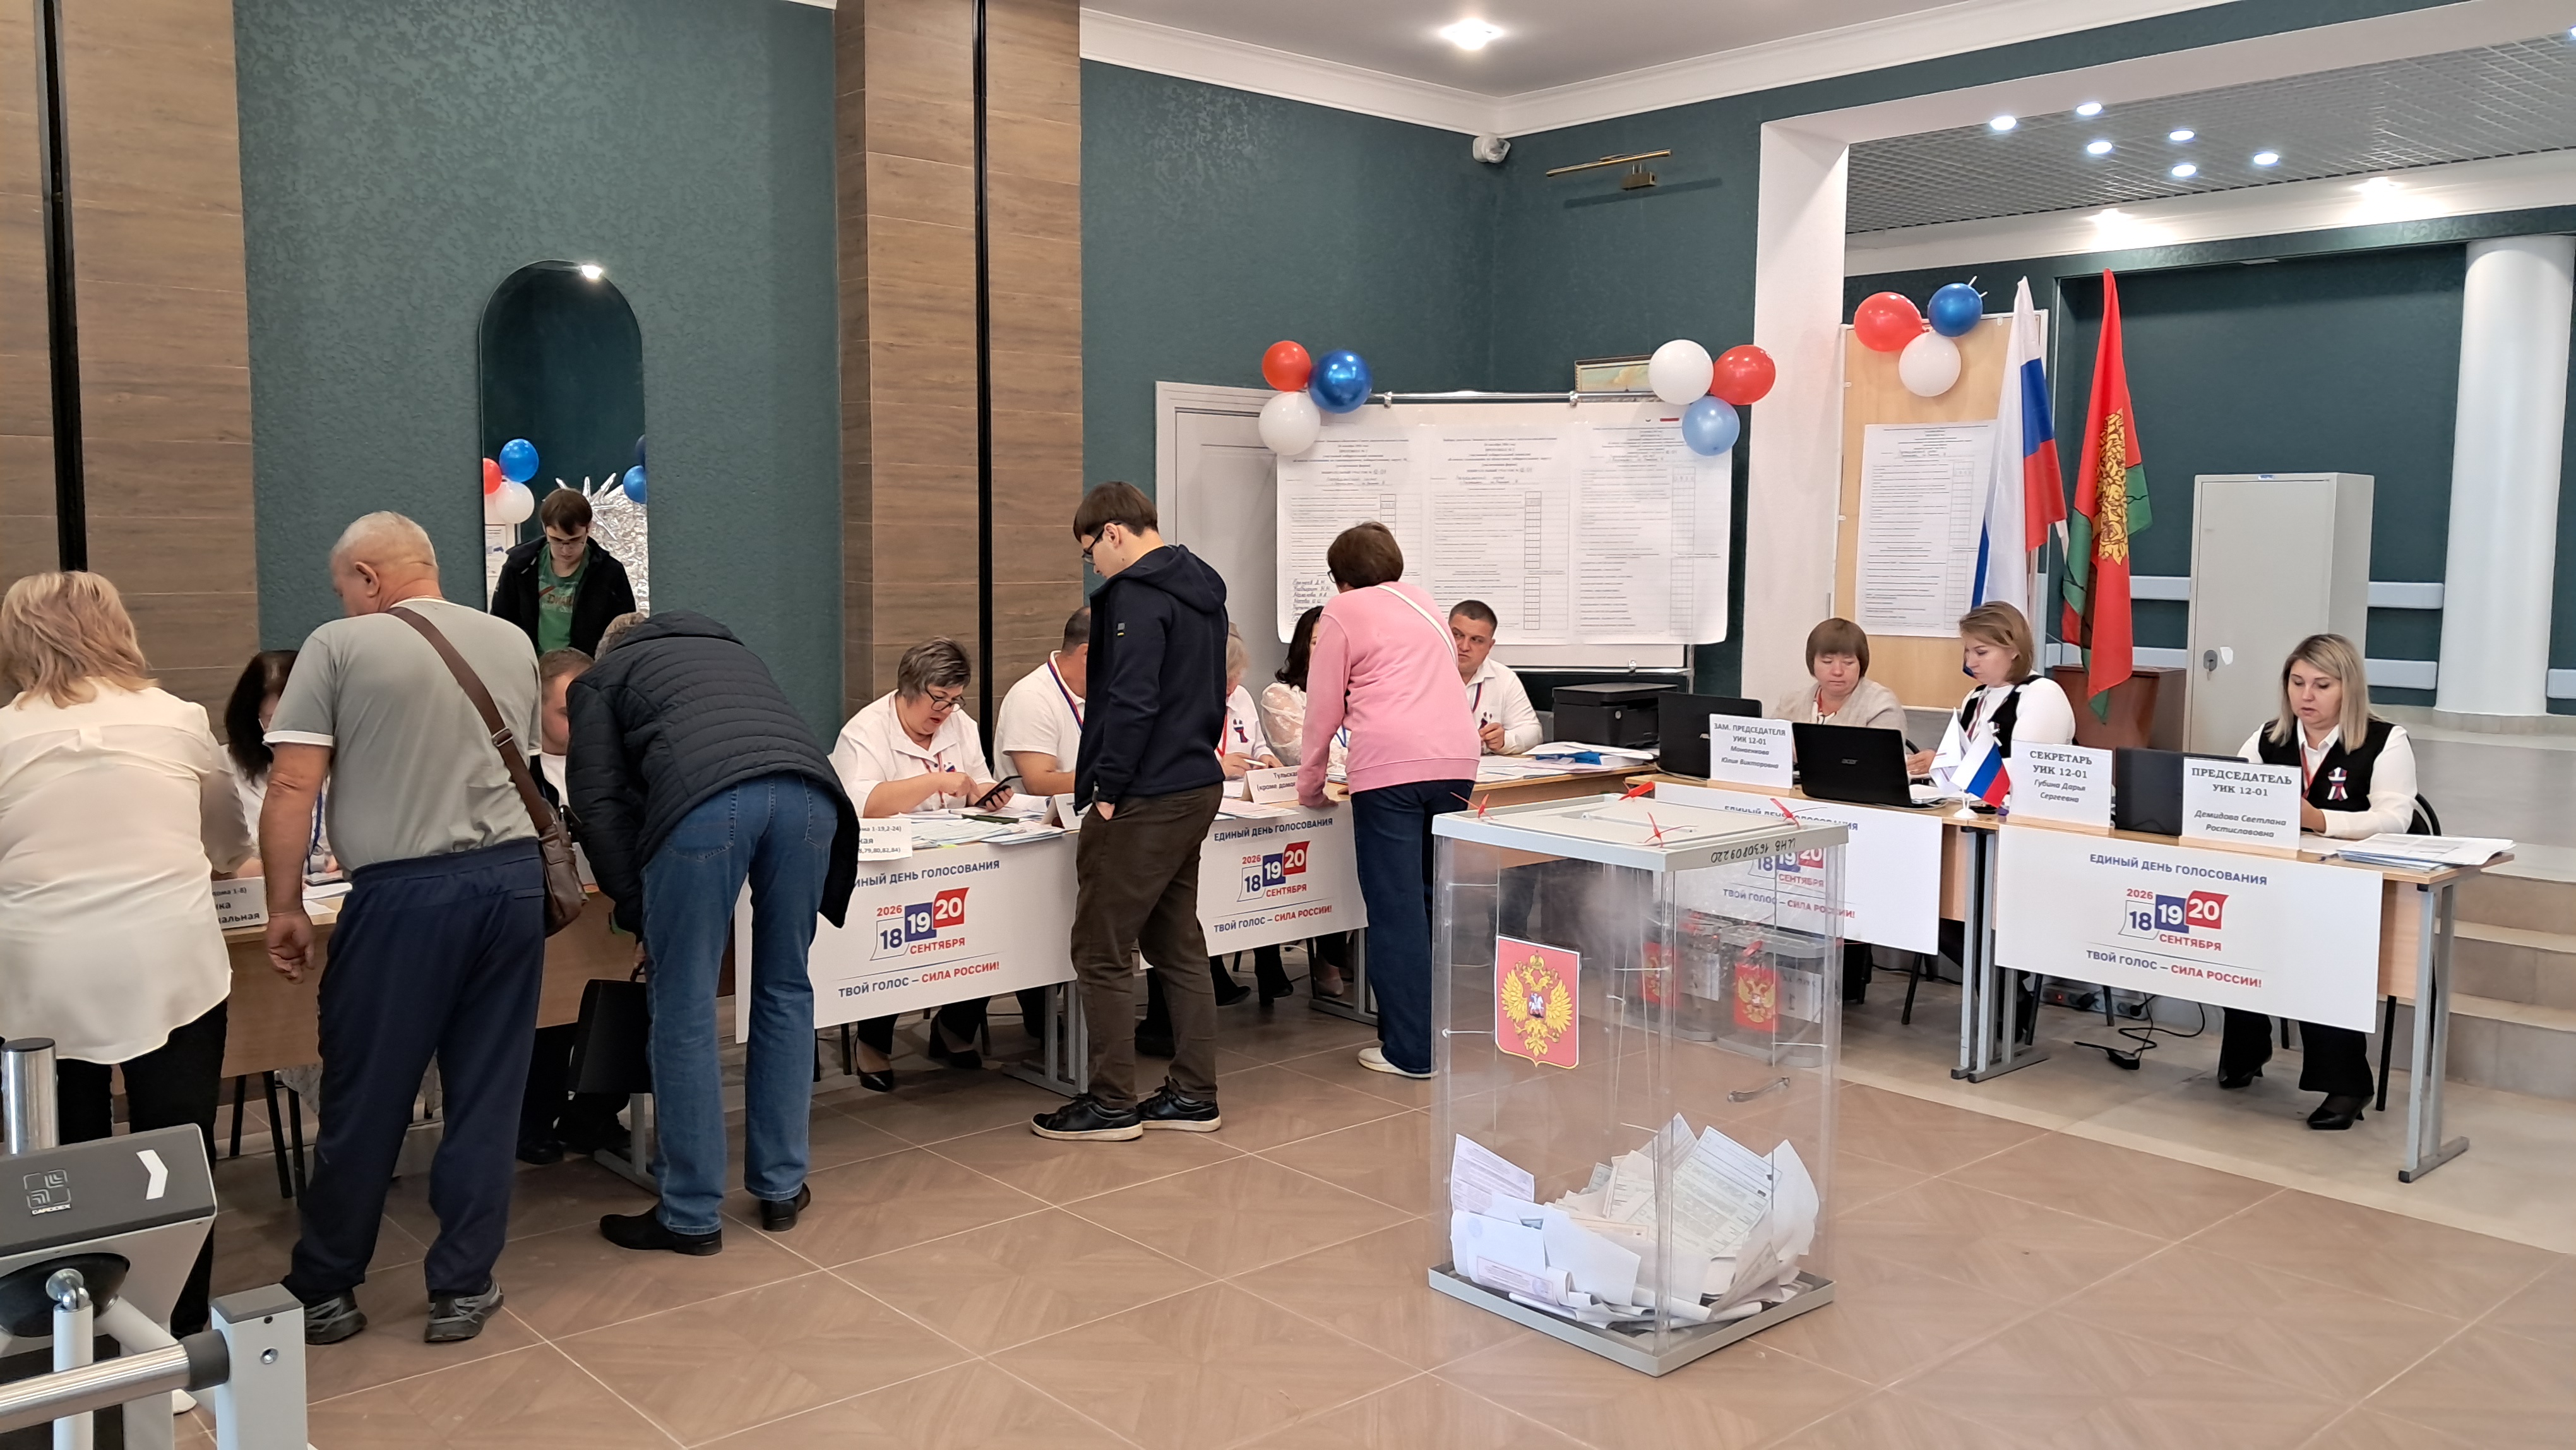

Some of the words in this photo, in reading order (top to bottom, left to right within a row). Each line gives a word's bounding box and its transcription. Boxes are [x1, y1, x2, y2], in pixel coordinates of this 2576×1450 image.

[1732, 725, 1786, 736] ПРЕДСЕДАТЕЛЯ
[2030, 750, 2092, 765] СЕКРЕТАРЬ
[2033, 765, 2056, 775] УИК
[2060, 768, 2087, 779] 12-01
[2191, 767, 2293, 785] ПРЕДСЕДАТЕЛЬ
[2034, 779, 2061, 788] Губина
[2061, 782, 2086, 791] Дарья
[2212, 784, 2236, 793] УИК
[2239, 787, 2269, 796] 12-01
[2040, 791, 2080, 803] Сергеевна
[2194, 810, 2239, 821] Демидова
[2241, 815, 2287, 826] Светлана
[1214, 827, 1249, 841] ЕДИНЫЙ
[1251, 826, 1273, 837] ДЕНЬ
[1275, 818, 1333, 833] ГОЛОСОВАНИЯ
[2205, 824, 2275, 838] Ростиславовна
[1242, 854, 1261, 865] 2026
[855, 873, 886, 888] ИНЫЙ
[889, 872, 919, 884] ДЕНЬ
[921, 860, 1000, 879] ГОЛОСОВАНИЯ
[1244, 875, 1261, 893] 18
[1265, 861, 1282, 880] 19
[1284, 849, 1305, 868] 20
[2090, 854, 2138, 868] ЕДИНЫЙ
[2141, 861, 2173, 873] ДЕНЬ
[2175, 865, 2267, 885] ГОЛОСОВАНИЯ
[1266, 884, 1307, 897] СЕНТЯБРЯ
[2126, 888, 2154, 900] 2026
[876, 904, 903, 916] 2026
[1787, 900, 1811, 911] СИЛА
[1213, 920, 1236, 933] ТВОЙ
[1238, 916, 1266, 929] ГОЛОС
[1274, 912, 1296, 922] СИЛА
[1297, 905, 1332, 918] РОССИИ!
[2129, 911, 2152, 932] 18
[2157, 904, 2183, 925] 19
[2188, 898, 2220, 921] 20
[880, 928, 903, 950] 18
[907, 911, 931, 935] 19
[934, 897, 963, 920] 20
[910, 937, 965, 954] СЕНТЯБРЯ
[2159, 933, 2222, 951] СЕНТЯБРЯ
[2086, 950, 2116, 963] ТВОЙ
[2119, 956, 2157, 970] ГОЛОС
[2171, 964, 2203, 978] СИЛА
[2207, 971, 2262, 988] РОССИИ!
[838, 981, 869, 998] ТВОЙ
[872, 977, 909, 992] ГОЛОС
[921, 970, 951, 983] СИЛА
[954, 961, 999, 978] РОССИИ!
